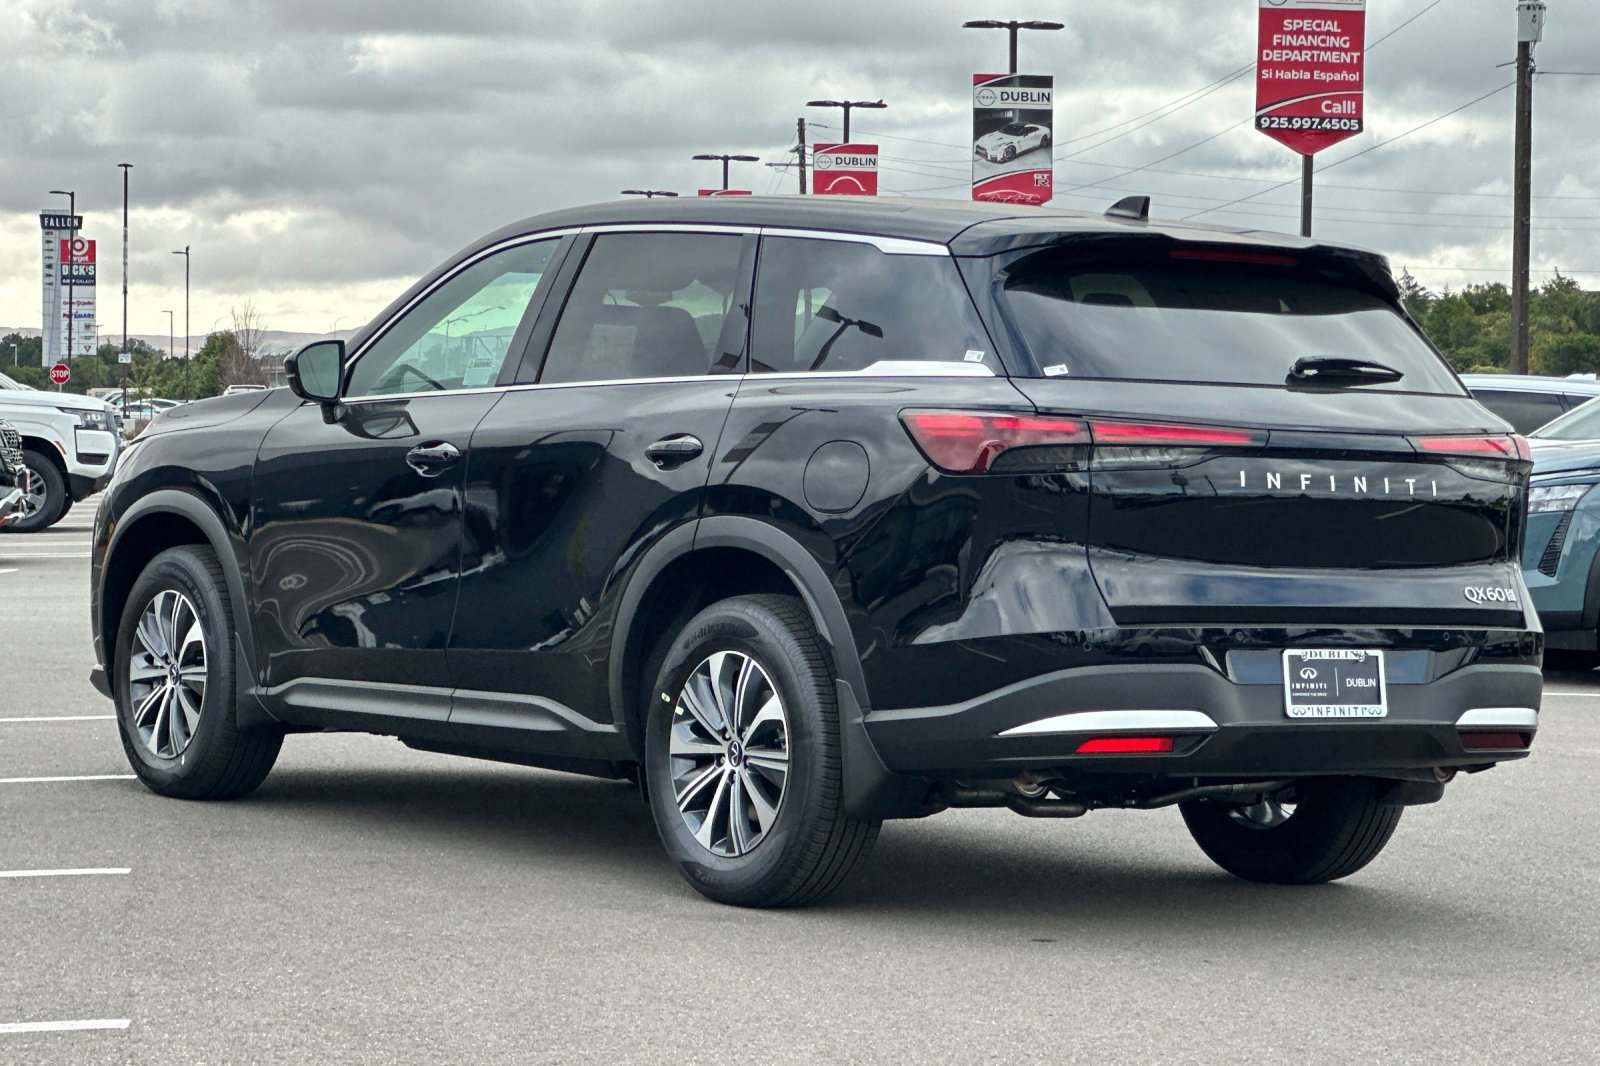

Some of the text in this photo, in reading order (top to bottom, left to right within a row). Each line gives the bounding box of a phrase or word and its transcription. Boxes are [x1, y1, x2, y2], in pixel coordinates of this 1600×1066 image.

[1283, 19, 1341, 32] SPECIAL
[1273, 35, 1350, 48] FINANCING
[1262, 49, 1360, 64] DEPARTMENT
[1261, 69, 1360, 82] Si Habla Español
[1000, 91, 1051, 102] DUBLIN
[1321, 100, 1356, 114] Call!
[1260, 117, 1359, 130] 925.997.4505
[835, 156, 876, 166] DUBLIN
[62, 264, 95, 276] DCK'S
[51, 369, 69, 378] STOP
[1239, 470, 1437, 497] INFINITI
[1464, 586, 1506, 604] QX60
[1346, 678, 1376, 687] DUBLIN
[1311, 706, 1364, 716] INFINITI
